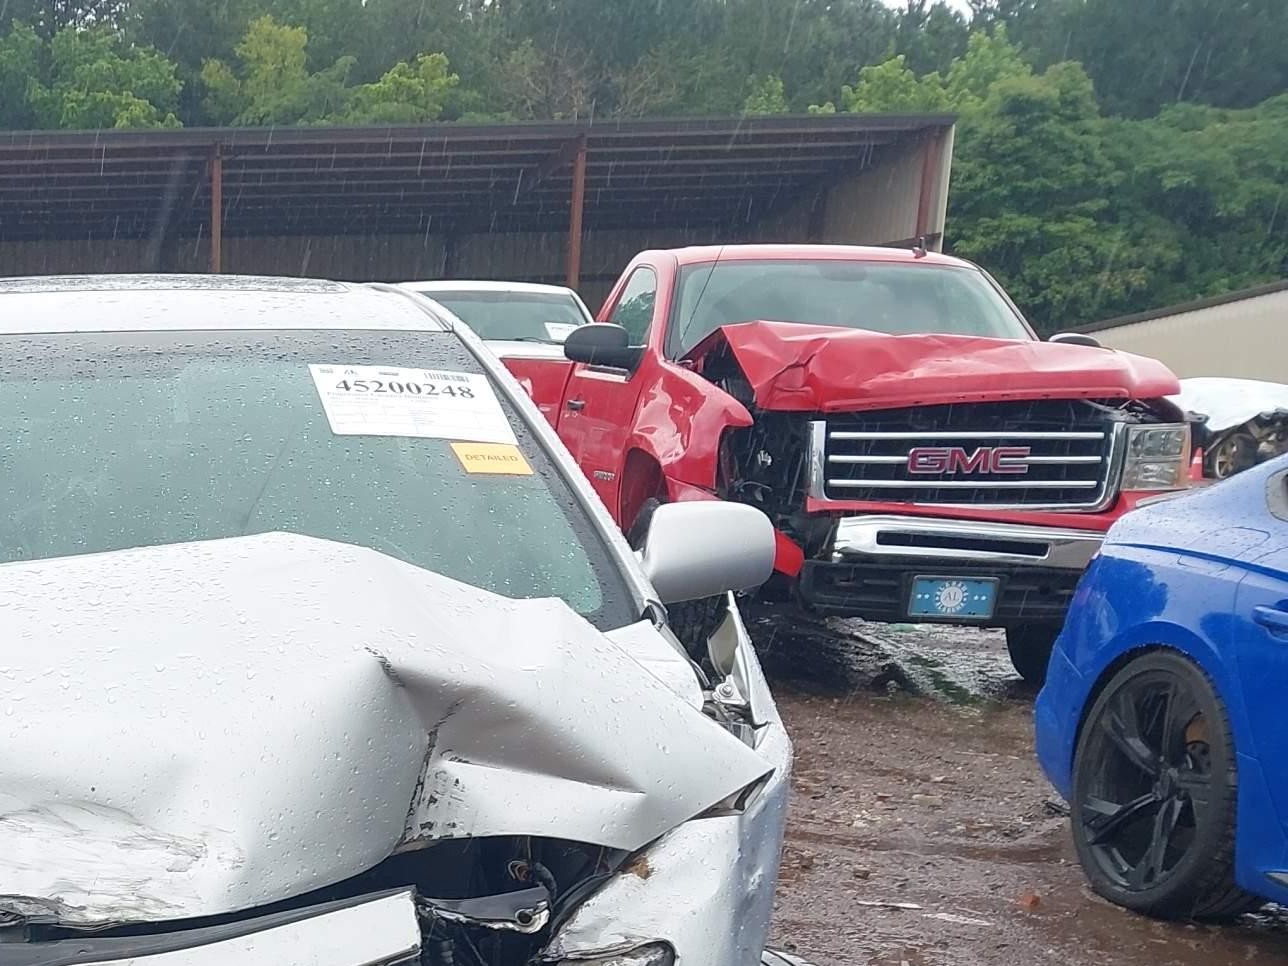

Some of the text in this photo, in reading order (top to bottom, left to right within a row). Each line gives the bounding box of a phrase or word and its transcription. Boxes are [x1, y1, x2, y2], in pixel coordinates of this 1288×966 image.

[335, 379, 475, 399] 45200248
[464, 453, 519, 463] DETAILED
[908, 446, 1031, 474] GMC
